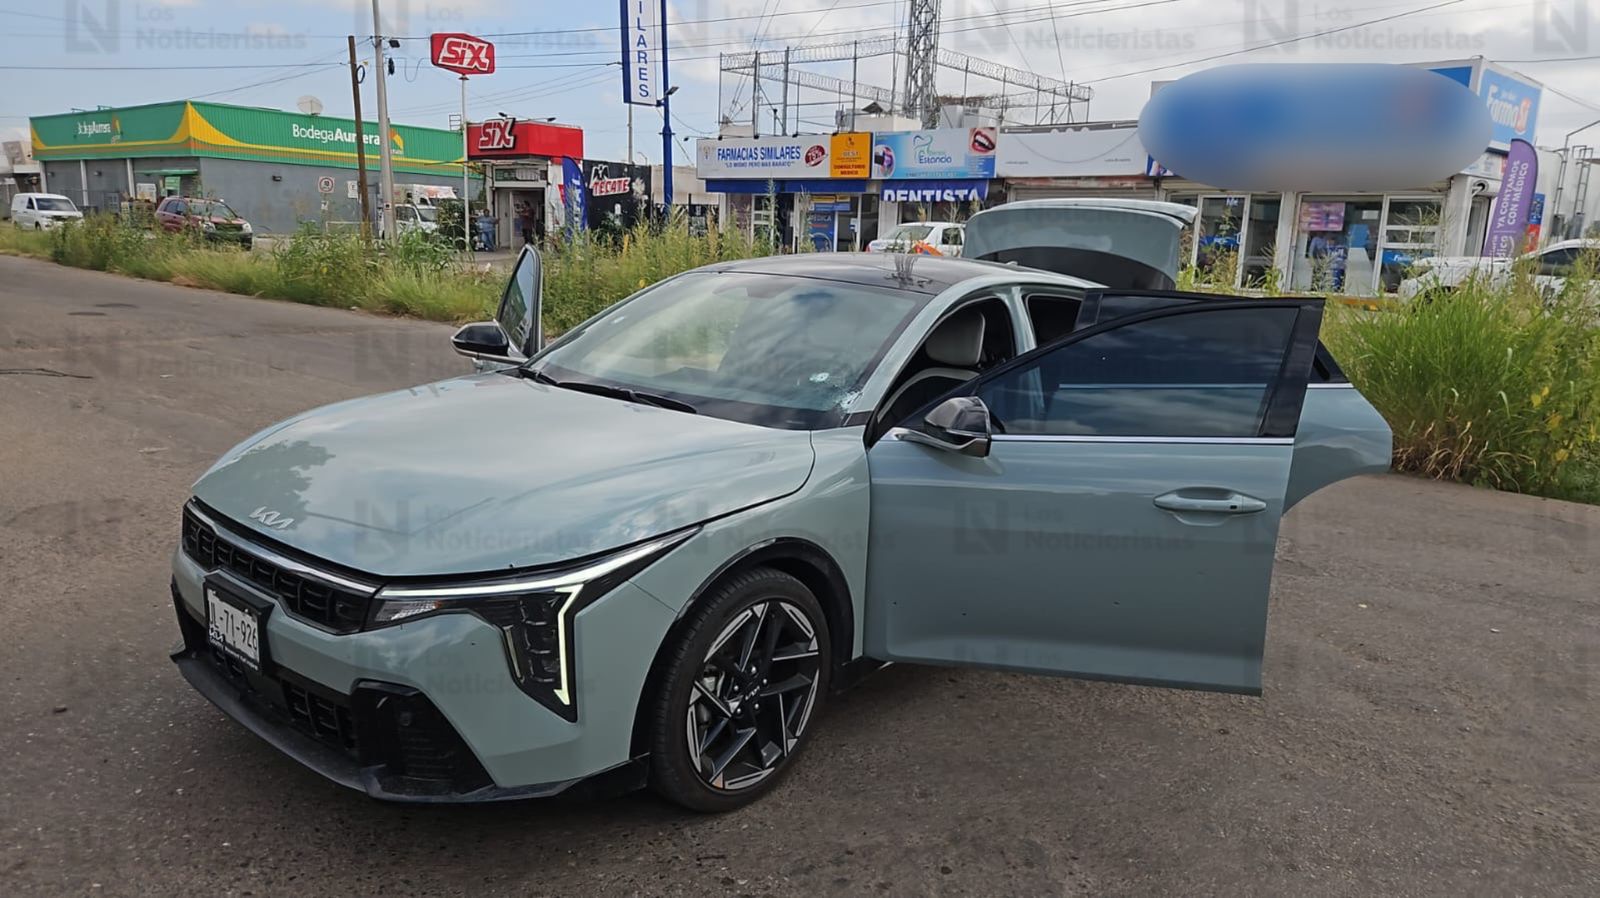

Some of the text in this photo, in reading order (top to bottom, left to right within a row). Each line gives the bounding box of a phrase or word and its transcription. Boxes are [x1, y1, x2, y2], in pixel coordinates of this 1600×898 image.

[718, 147, 759, 161] FARMACIAS
[760, 145, 801, 160] SIMILARES
[593, 179, 629, 193] TECATE
[1499, 160, 1520, 216] CONTAMOS
[883, 188, 981, 202] DENTISTA
[1507, 203, 1520, 225] CON
